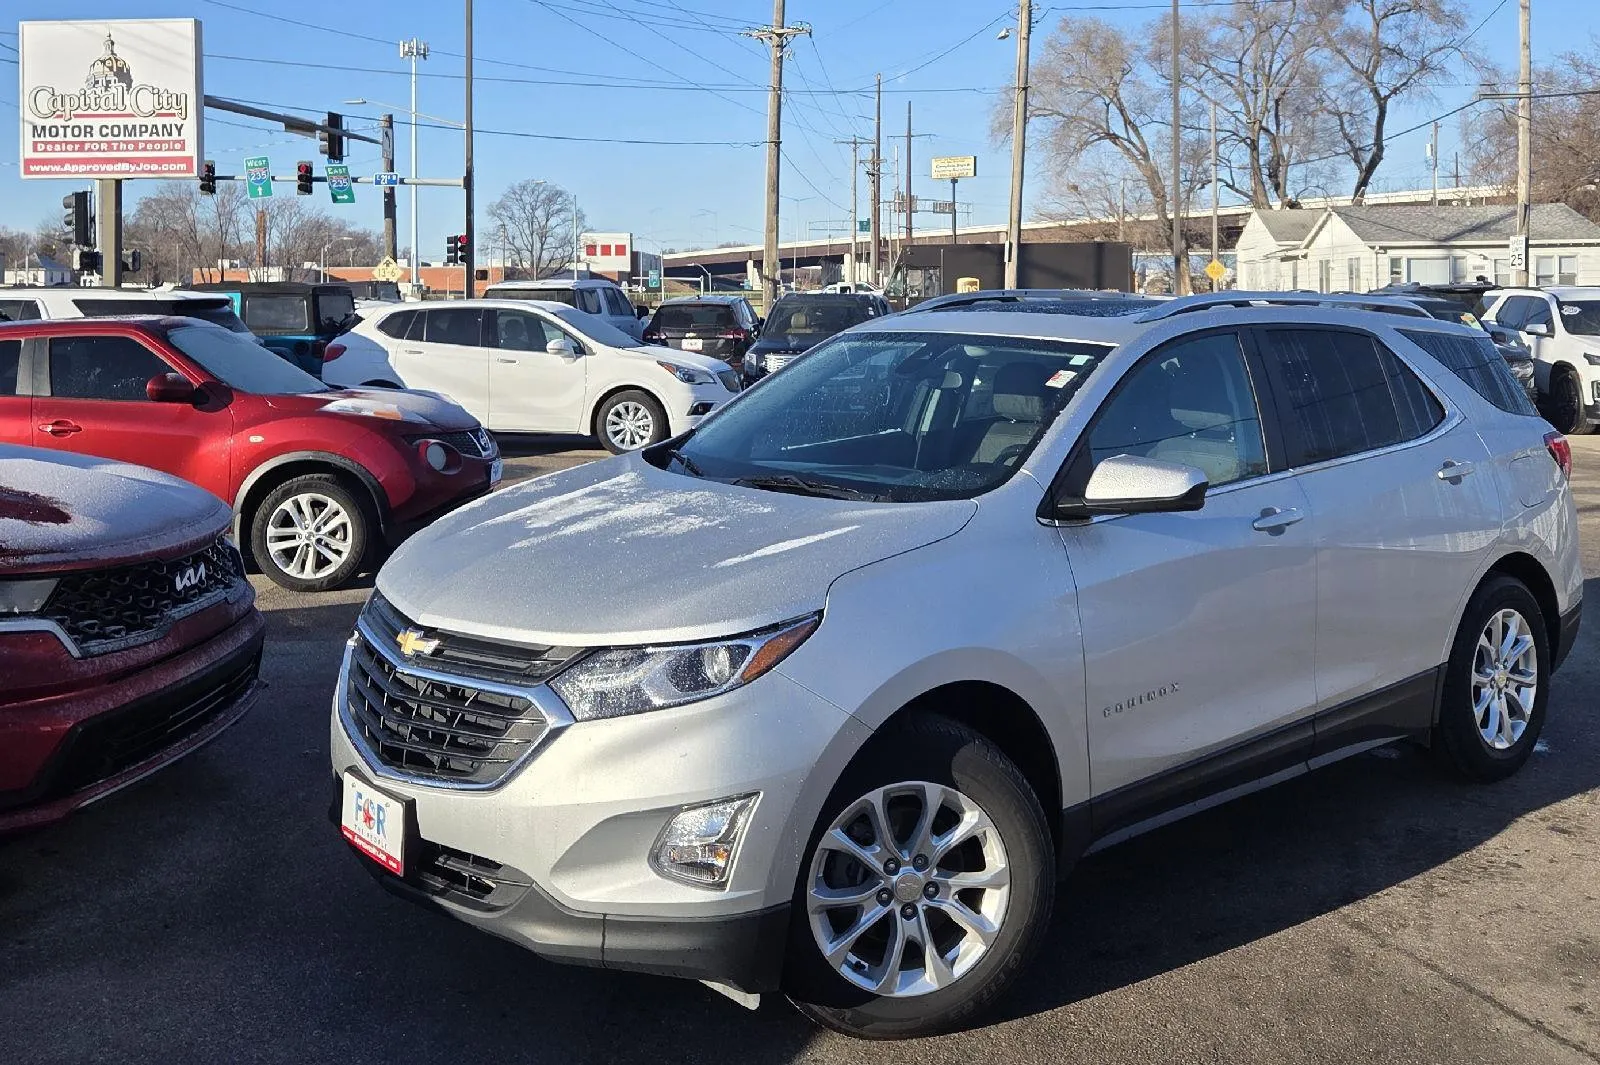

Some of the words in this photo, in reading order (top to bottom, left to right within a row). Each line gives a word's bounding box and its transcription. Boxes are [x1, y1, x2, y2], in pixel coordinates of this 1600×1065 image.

[28, 83, 127, 121] Capital
[130, 84, 188, 121] City
[32, 124, 94, 139] MOTOR
[99, 123, 185, 138] COMPANY
[37, 142, 80, 152] Dealer
[84, 142, 108, 151] FOR
[111, 141, 135, 151] The
[29, 162, 187, 173] www.ApprovedByJoe.com
[246, 159, 267, 167] WEST
[250, 171, 267, 180] 235
[327, 166, 347, 175] EAST
[331, 178, 348, 187] 235
[1510, 253, 1523, 267] 25
[1103, 682, 1179, 718] EQUINOX
